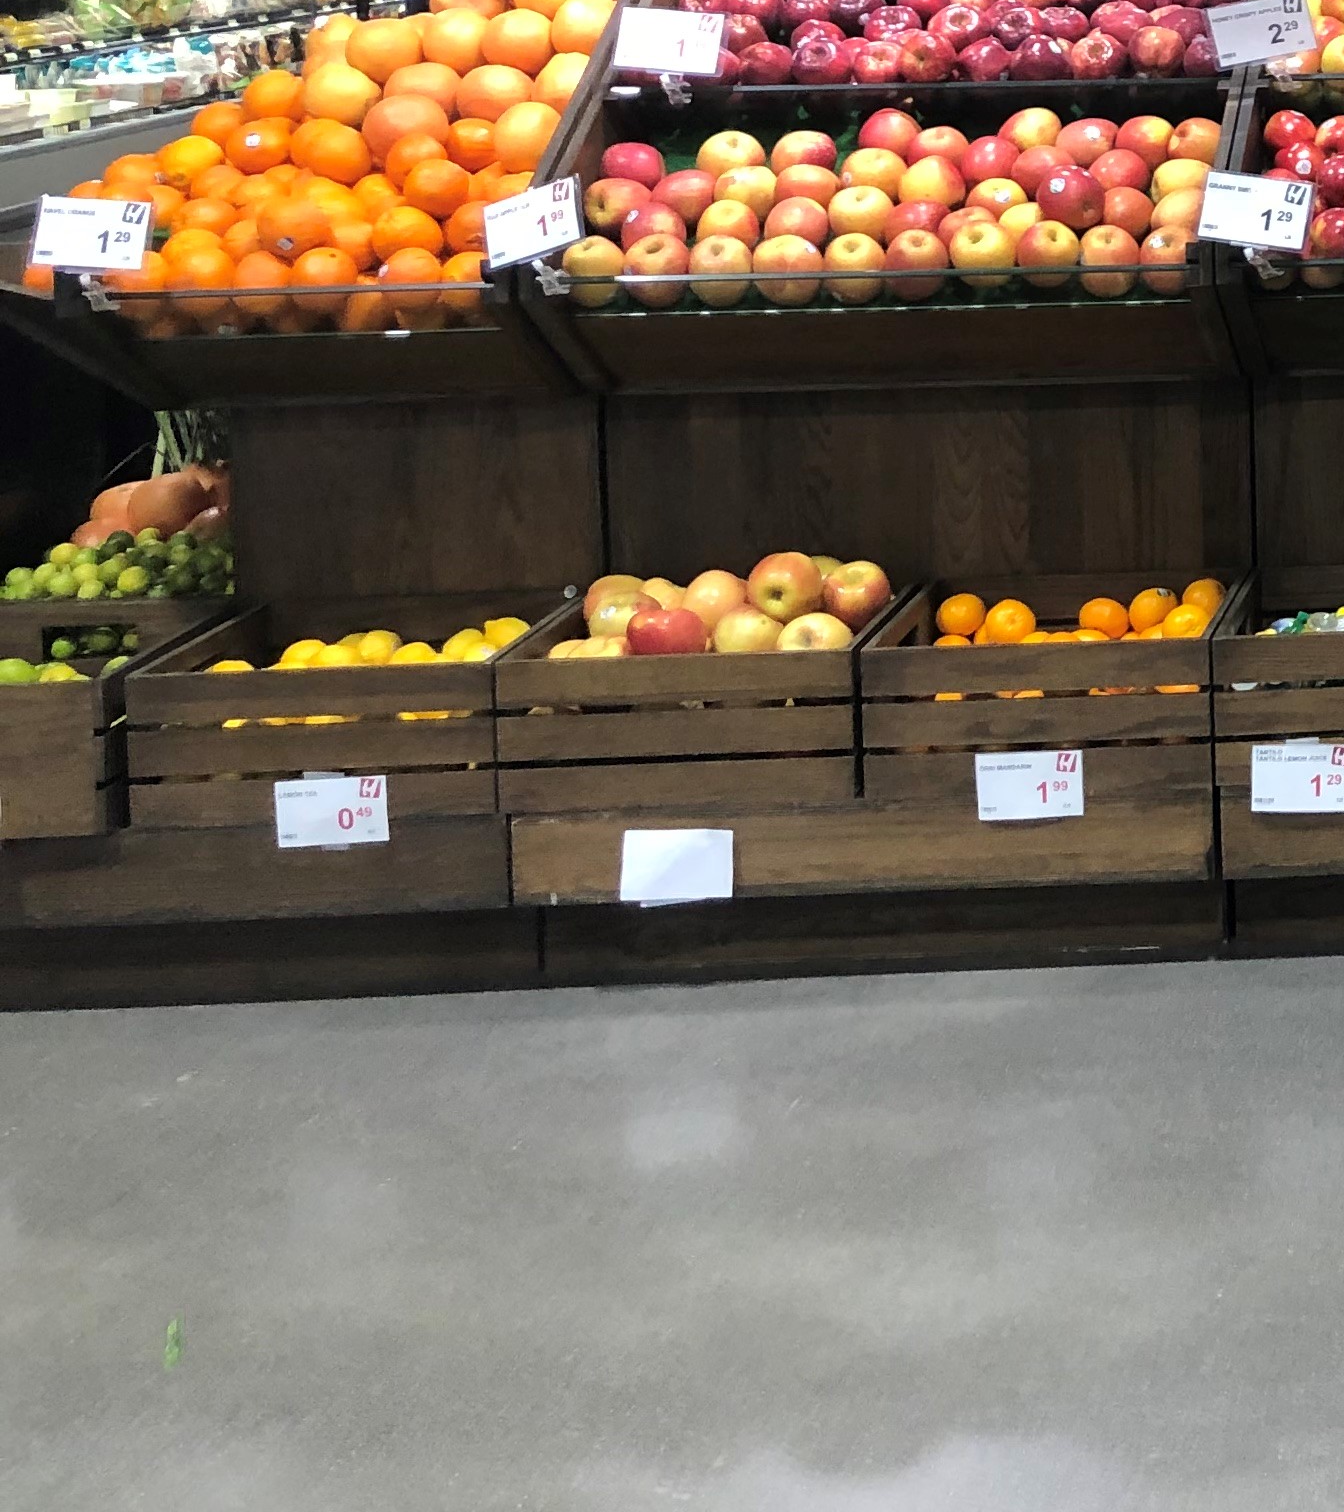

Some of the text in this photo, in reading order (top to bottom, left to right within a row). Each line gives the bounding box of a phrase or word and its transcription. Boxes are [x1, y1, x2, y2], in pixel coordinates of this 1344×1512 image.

[1268, 20, 1298, 44] 2 29
[537, 210, 563, 236] 1 99
[1261, 209, 1293, 231] 1 29
[98, 230, 131, 253] 1 29
[1037, 780, 1068, 803] 1 99
[1311, 774, 1342, 796] 1 29
[338, 807, 372, 830] 0 49
